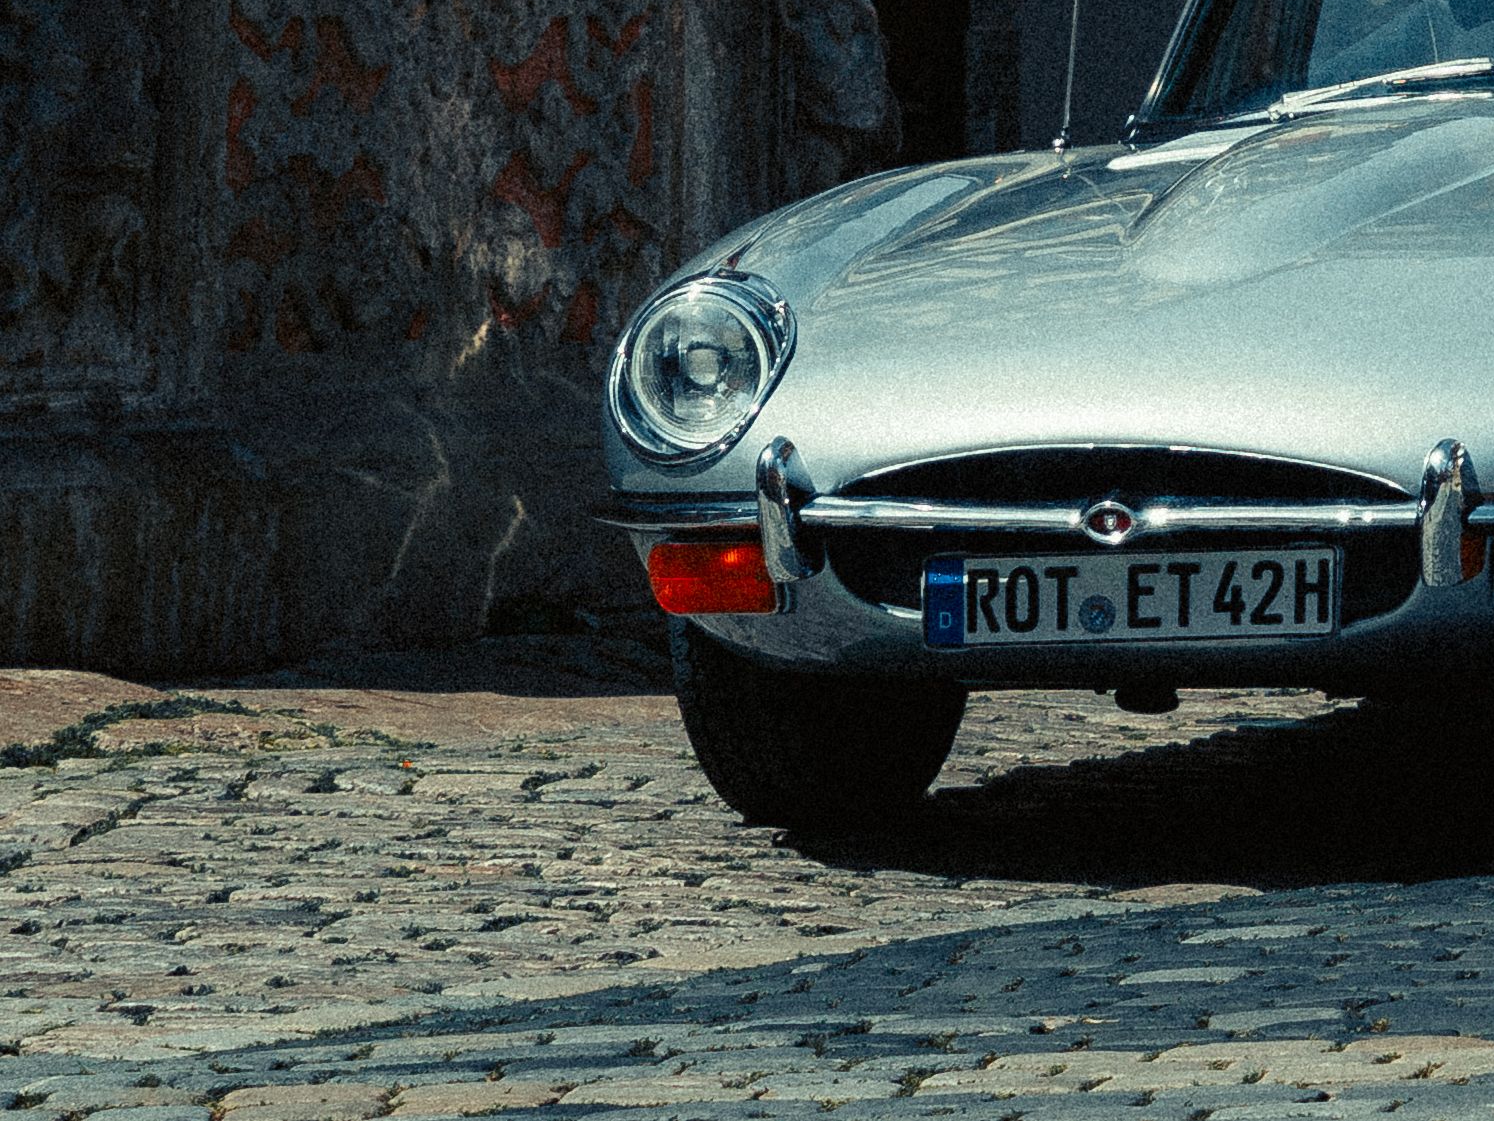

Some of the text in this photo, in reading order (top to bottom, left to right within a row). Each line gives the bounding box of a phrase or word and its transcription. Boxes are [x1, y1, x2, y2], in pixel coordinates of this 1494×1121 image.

[938, 611, 952, 629] D
[966, 557, 1330, 635] ROT ET 42H
